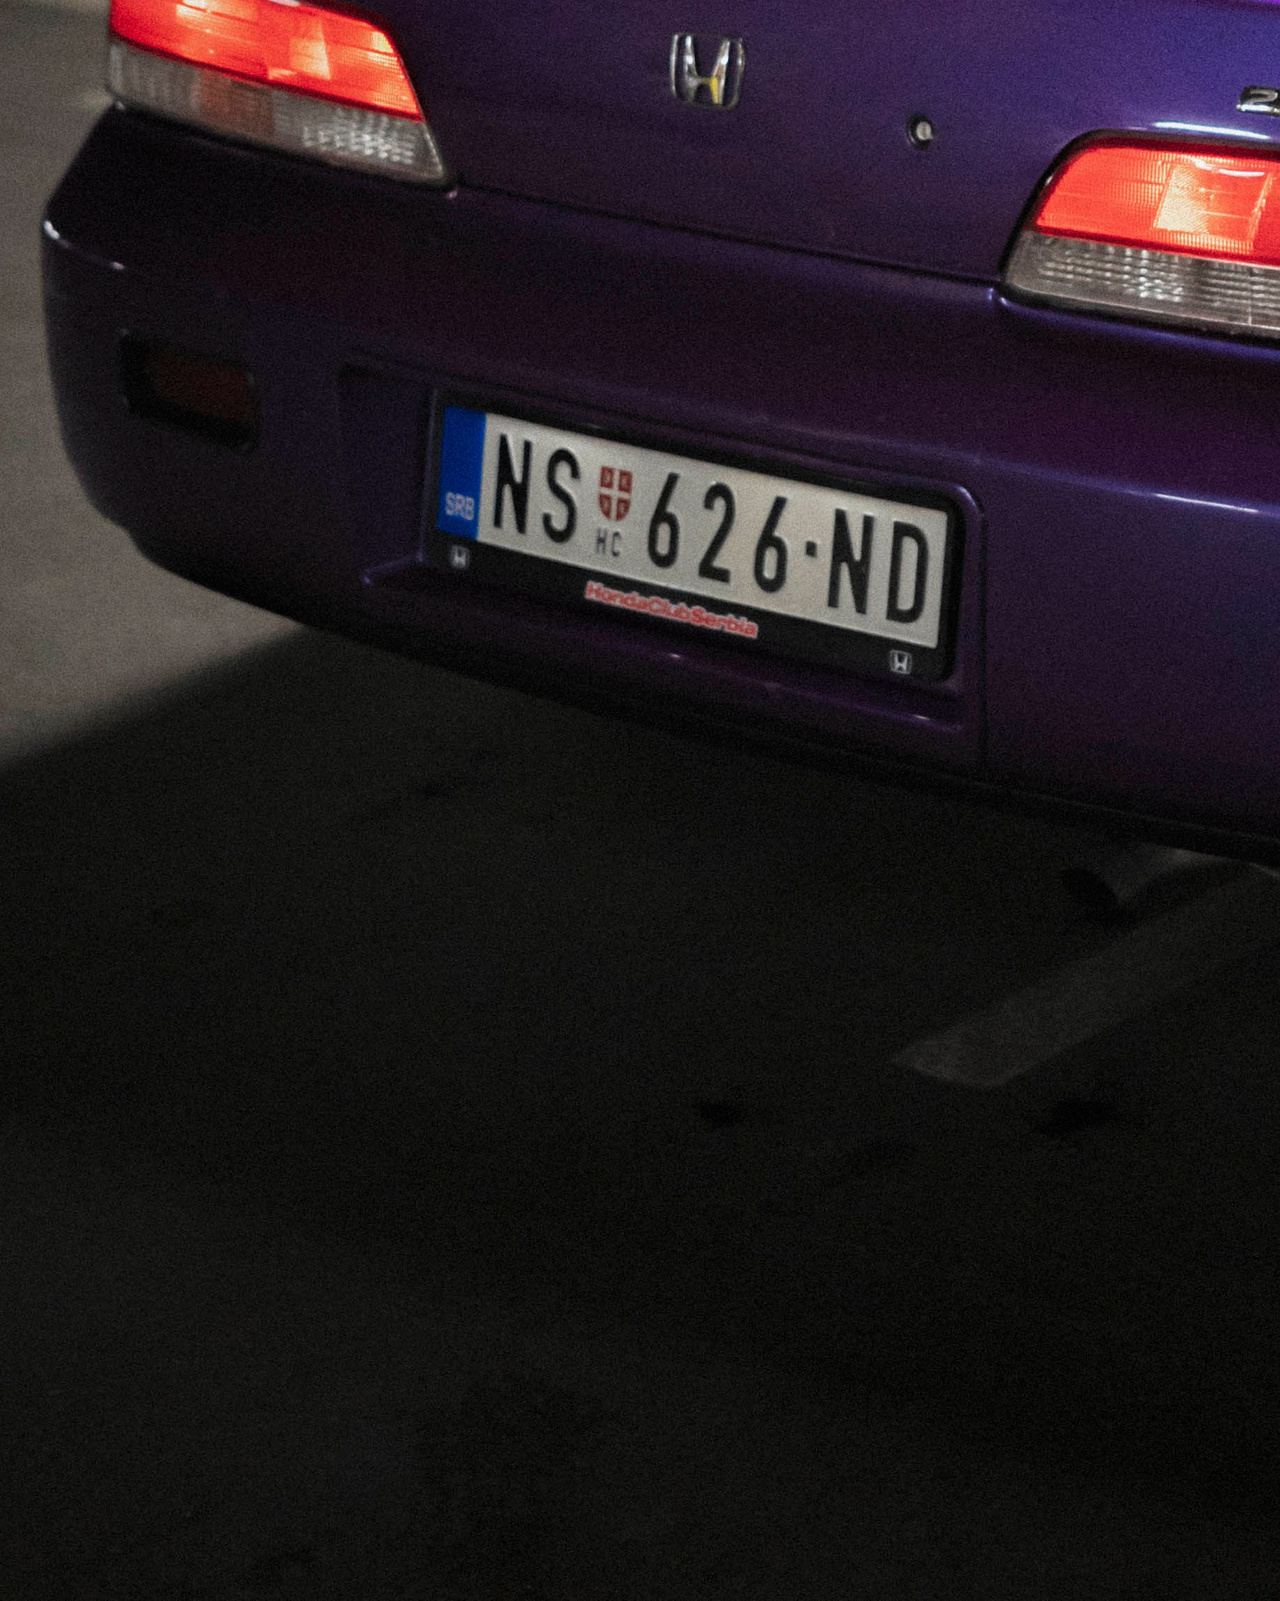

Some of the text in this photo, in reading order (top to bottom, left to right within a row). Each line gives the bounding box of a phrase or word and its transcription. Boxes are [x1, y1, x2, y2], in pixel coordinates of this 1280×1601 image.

[445, 491, 475, 522] SRB
[493, 432, 582, 544] NS
[584, 579, 759, 639] HondaClubSerbia
